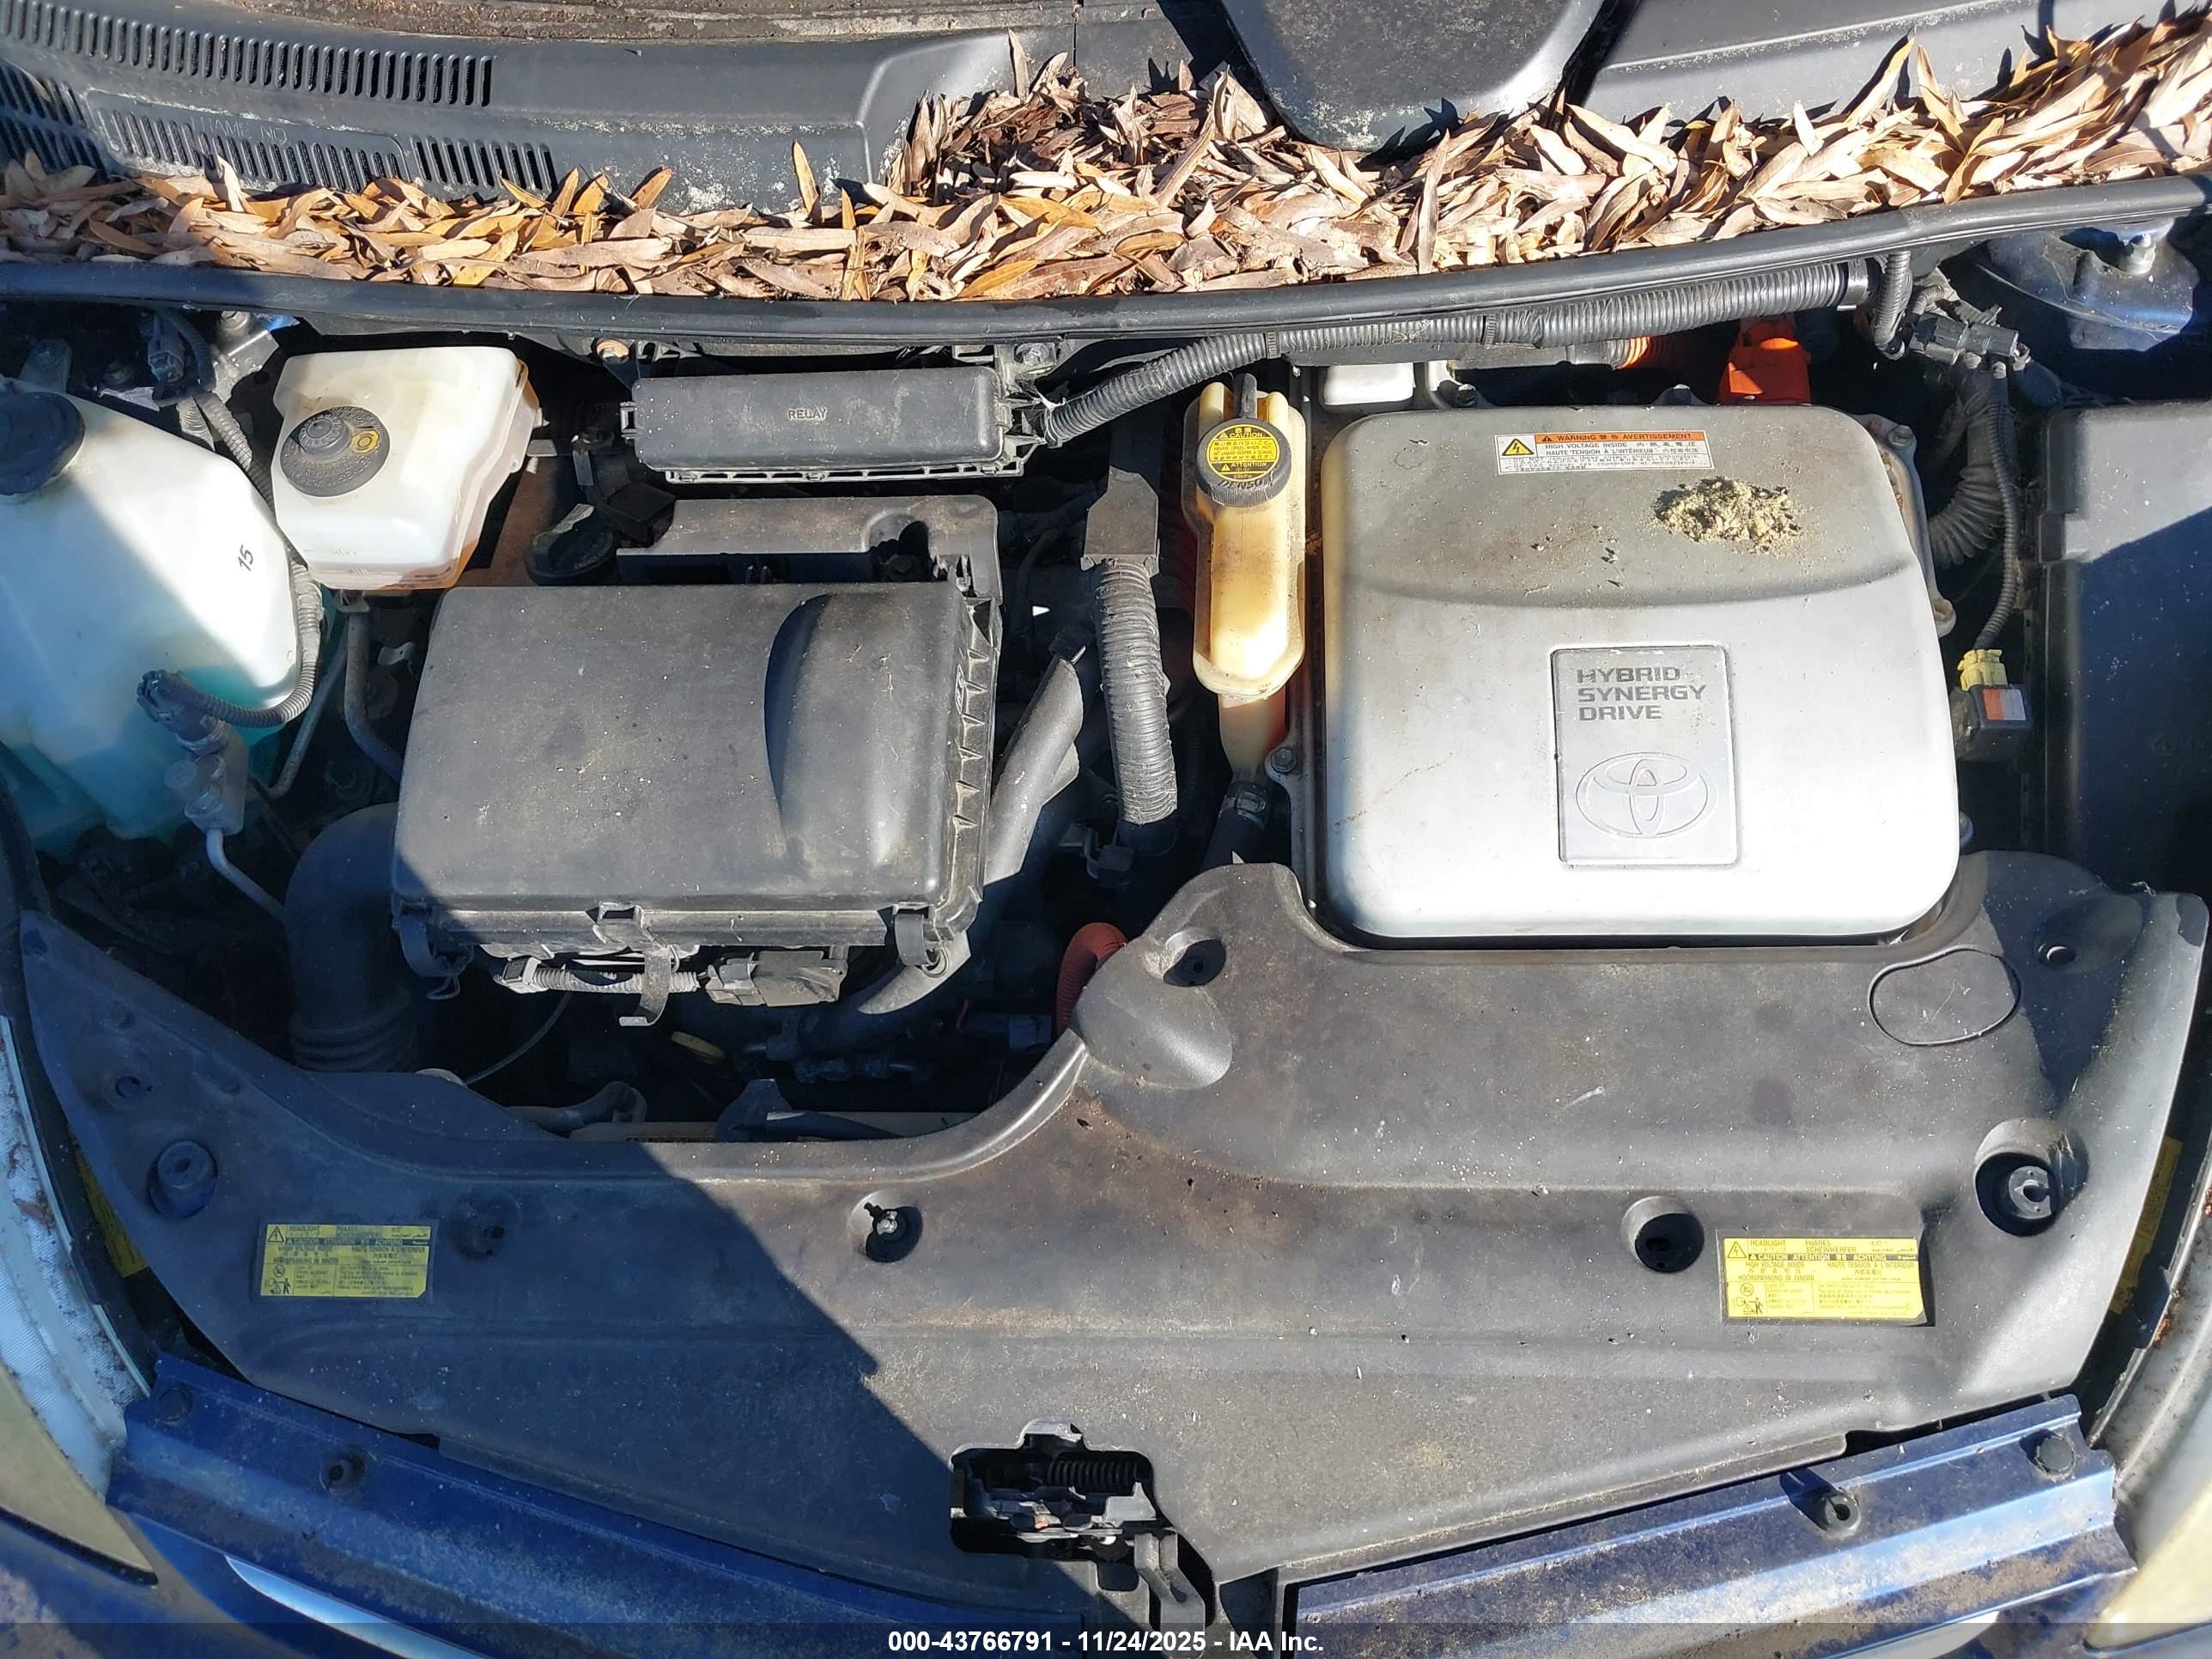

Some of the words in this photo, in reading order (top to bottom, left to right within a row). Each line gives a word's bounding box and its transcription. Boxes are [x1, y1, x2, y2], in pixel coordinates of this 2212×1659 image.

[787, 408, 828, 420] RELAY
[1218, 478, 1261, 489] DENSO
[237, 544, 254, 572] 15
[1577, 666, 1681, 683] HYBRID
[1577, 684, 1707, 702] SYNERGY
[1578, 704, 1662, 721] DRIVE
